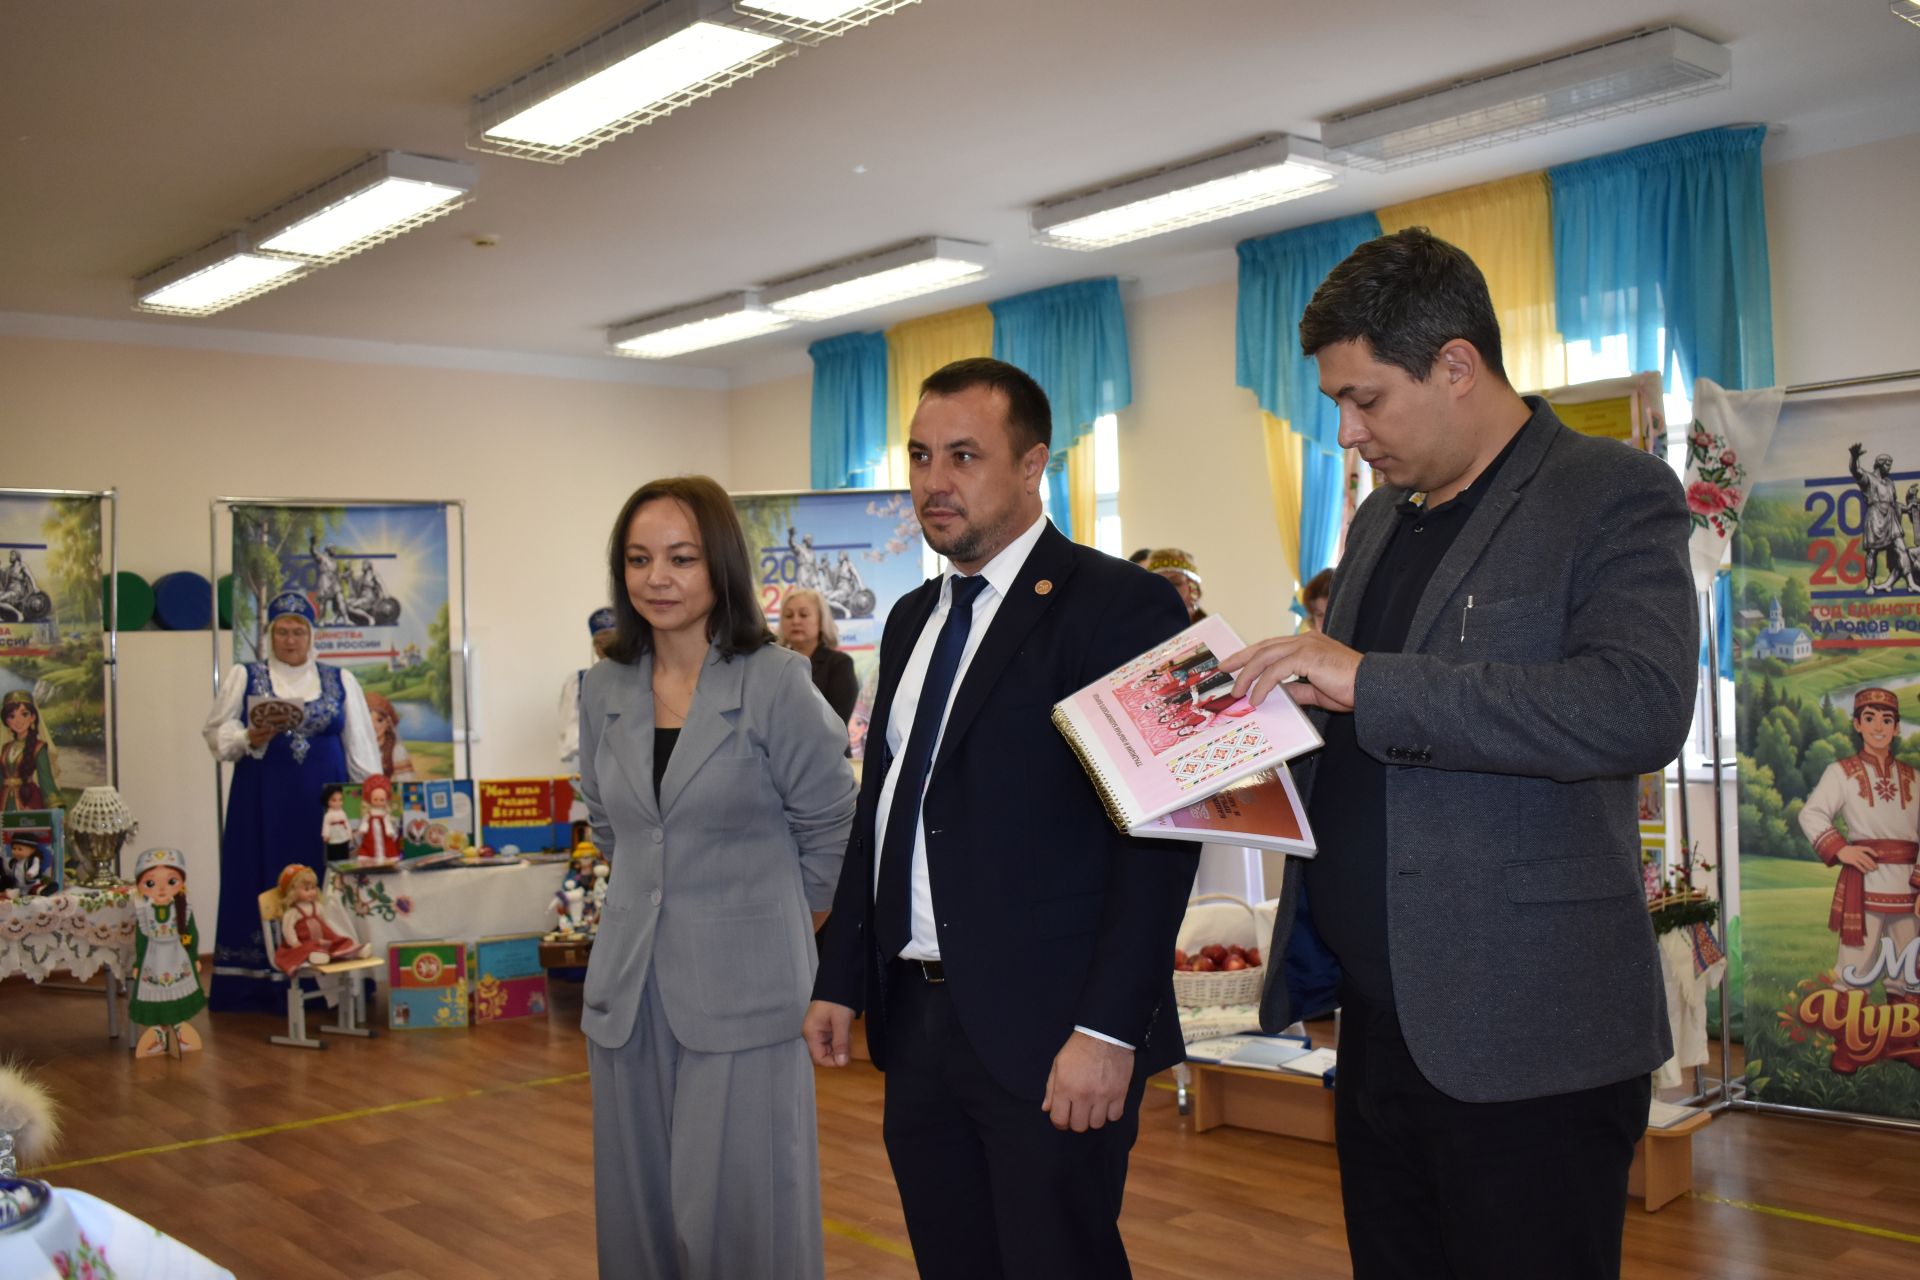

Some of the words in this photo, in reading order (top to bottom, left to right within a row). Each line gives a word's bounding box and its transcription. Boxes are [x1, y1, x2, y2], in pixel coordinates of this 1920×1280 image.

[1805, 489, 1866, 537] 20
[761, 555, 798, 584] 20
[1808, 538, 1867, 585] 26
[1812, 604, 1843, 619] ГОД
[1811, 620, 1889, 634] НАРОДОВ
[337, 640, 381, 649] РОССИИ
